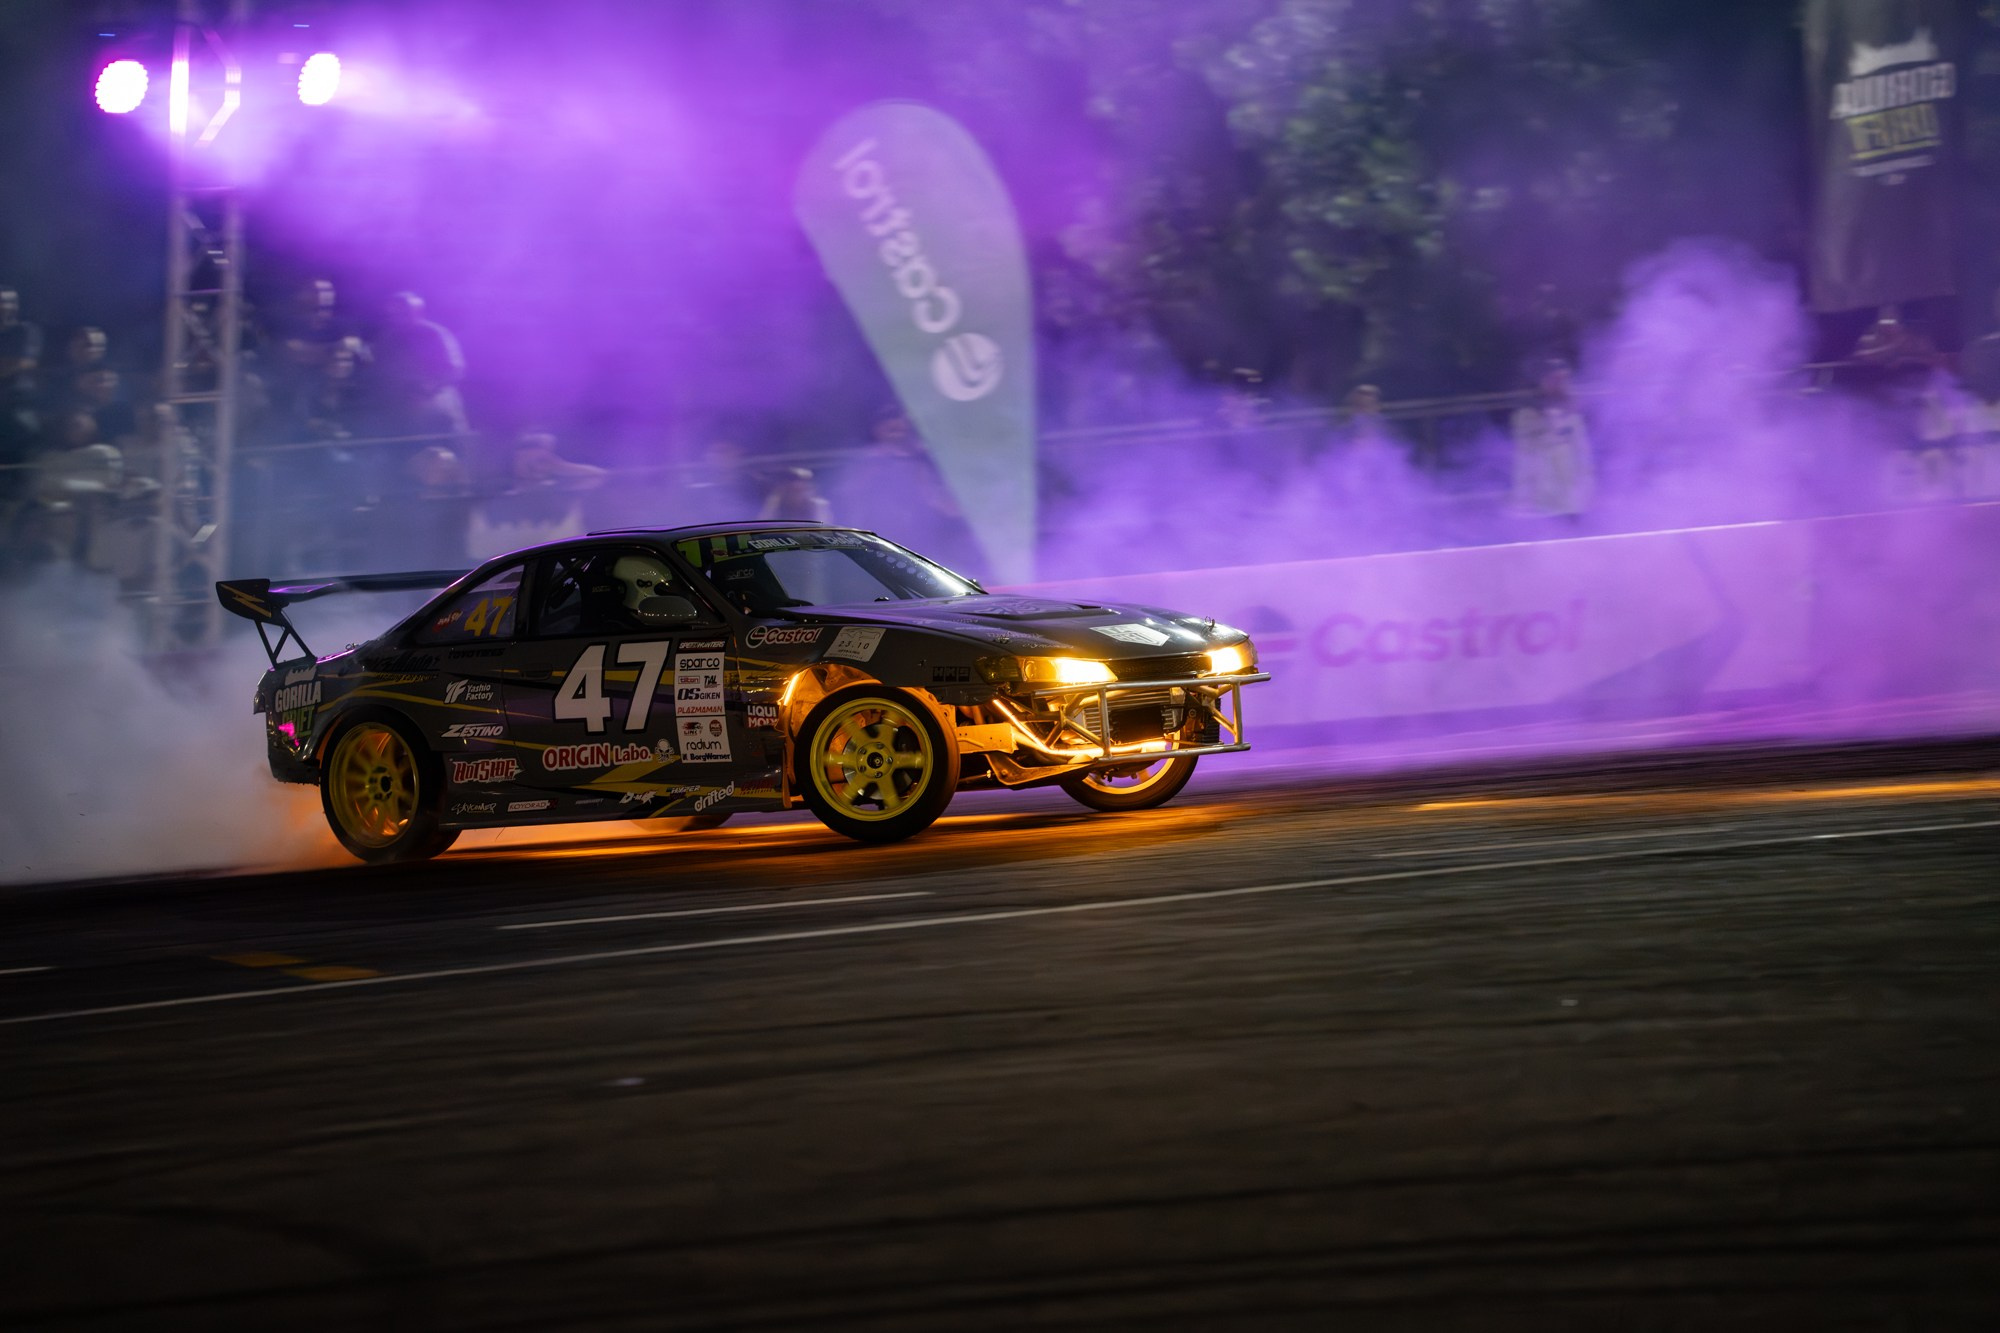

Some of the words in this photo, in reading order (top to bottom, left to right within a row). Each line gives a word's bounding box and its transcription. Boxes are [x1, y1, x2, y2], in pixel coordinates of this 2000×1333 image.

[464, 596, 514, 636] 47
[765, 628, 823, 644] Castrol
[1311, 600, 1588, 667] Castrol
[680, 657, 720, 671] sparco
[467, 684, 491, 693] Yashio
[553, 640, 671, 735] 47
[275, 681, 322, 713] GORILLA
[465, 692, 494, 701] Factory
[678, 706, 722, 714] PLAZMAMAN
[747, 705, 777, 717] LIQUI
[441, 723, 504, 738] ZESTINO
[687, 740, 722, 750] radium
[543, 744, 612, 771] ORIGIN
[613, 744, 653, 764] Labo.
[690, 753, 730, 761] BorgWarner
[695, 781, 735, 812] drifted
[509, 802, 547, 810] KOYORAD
